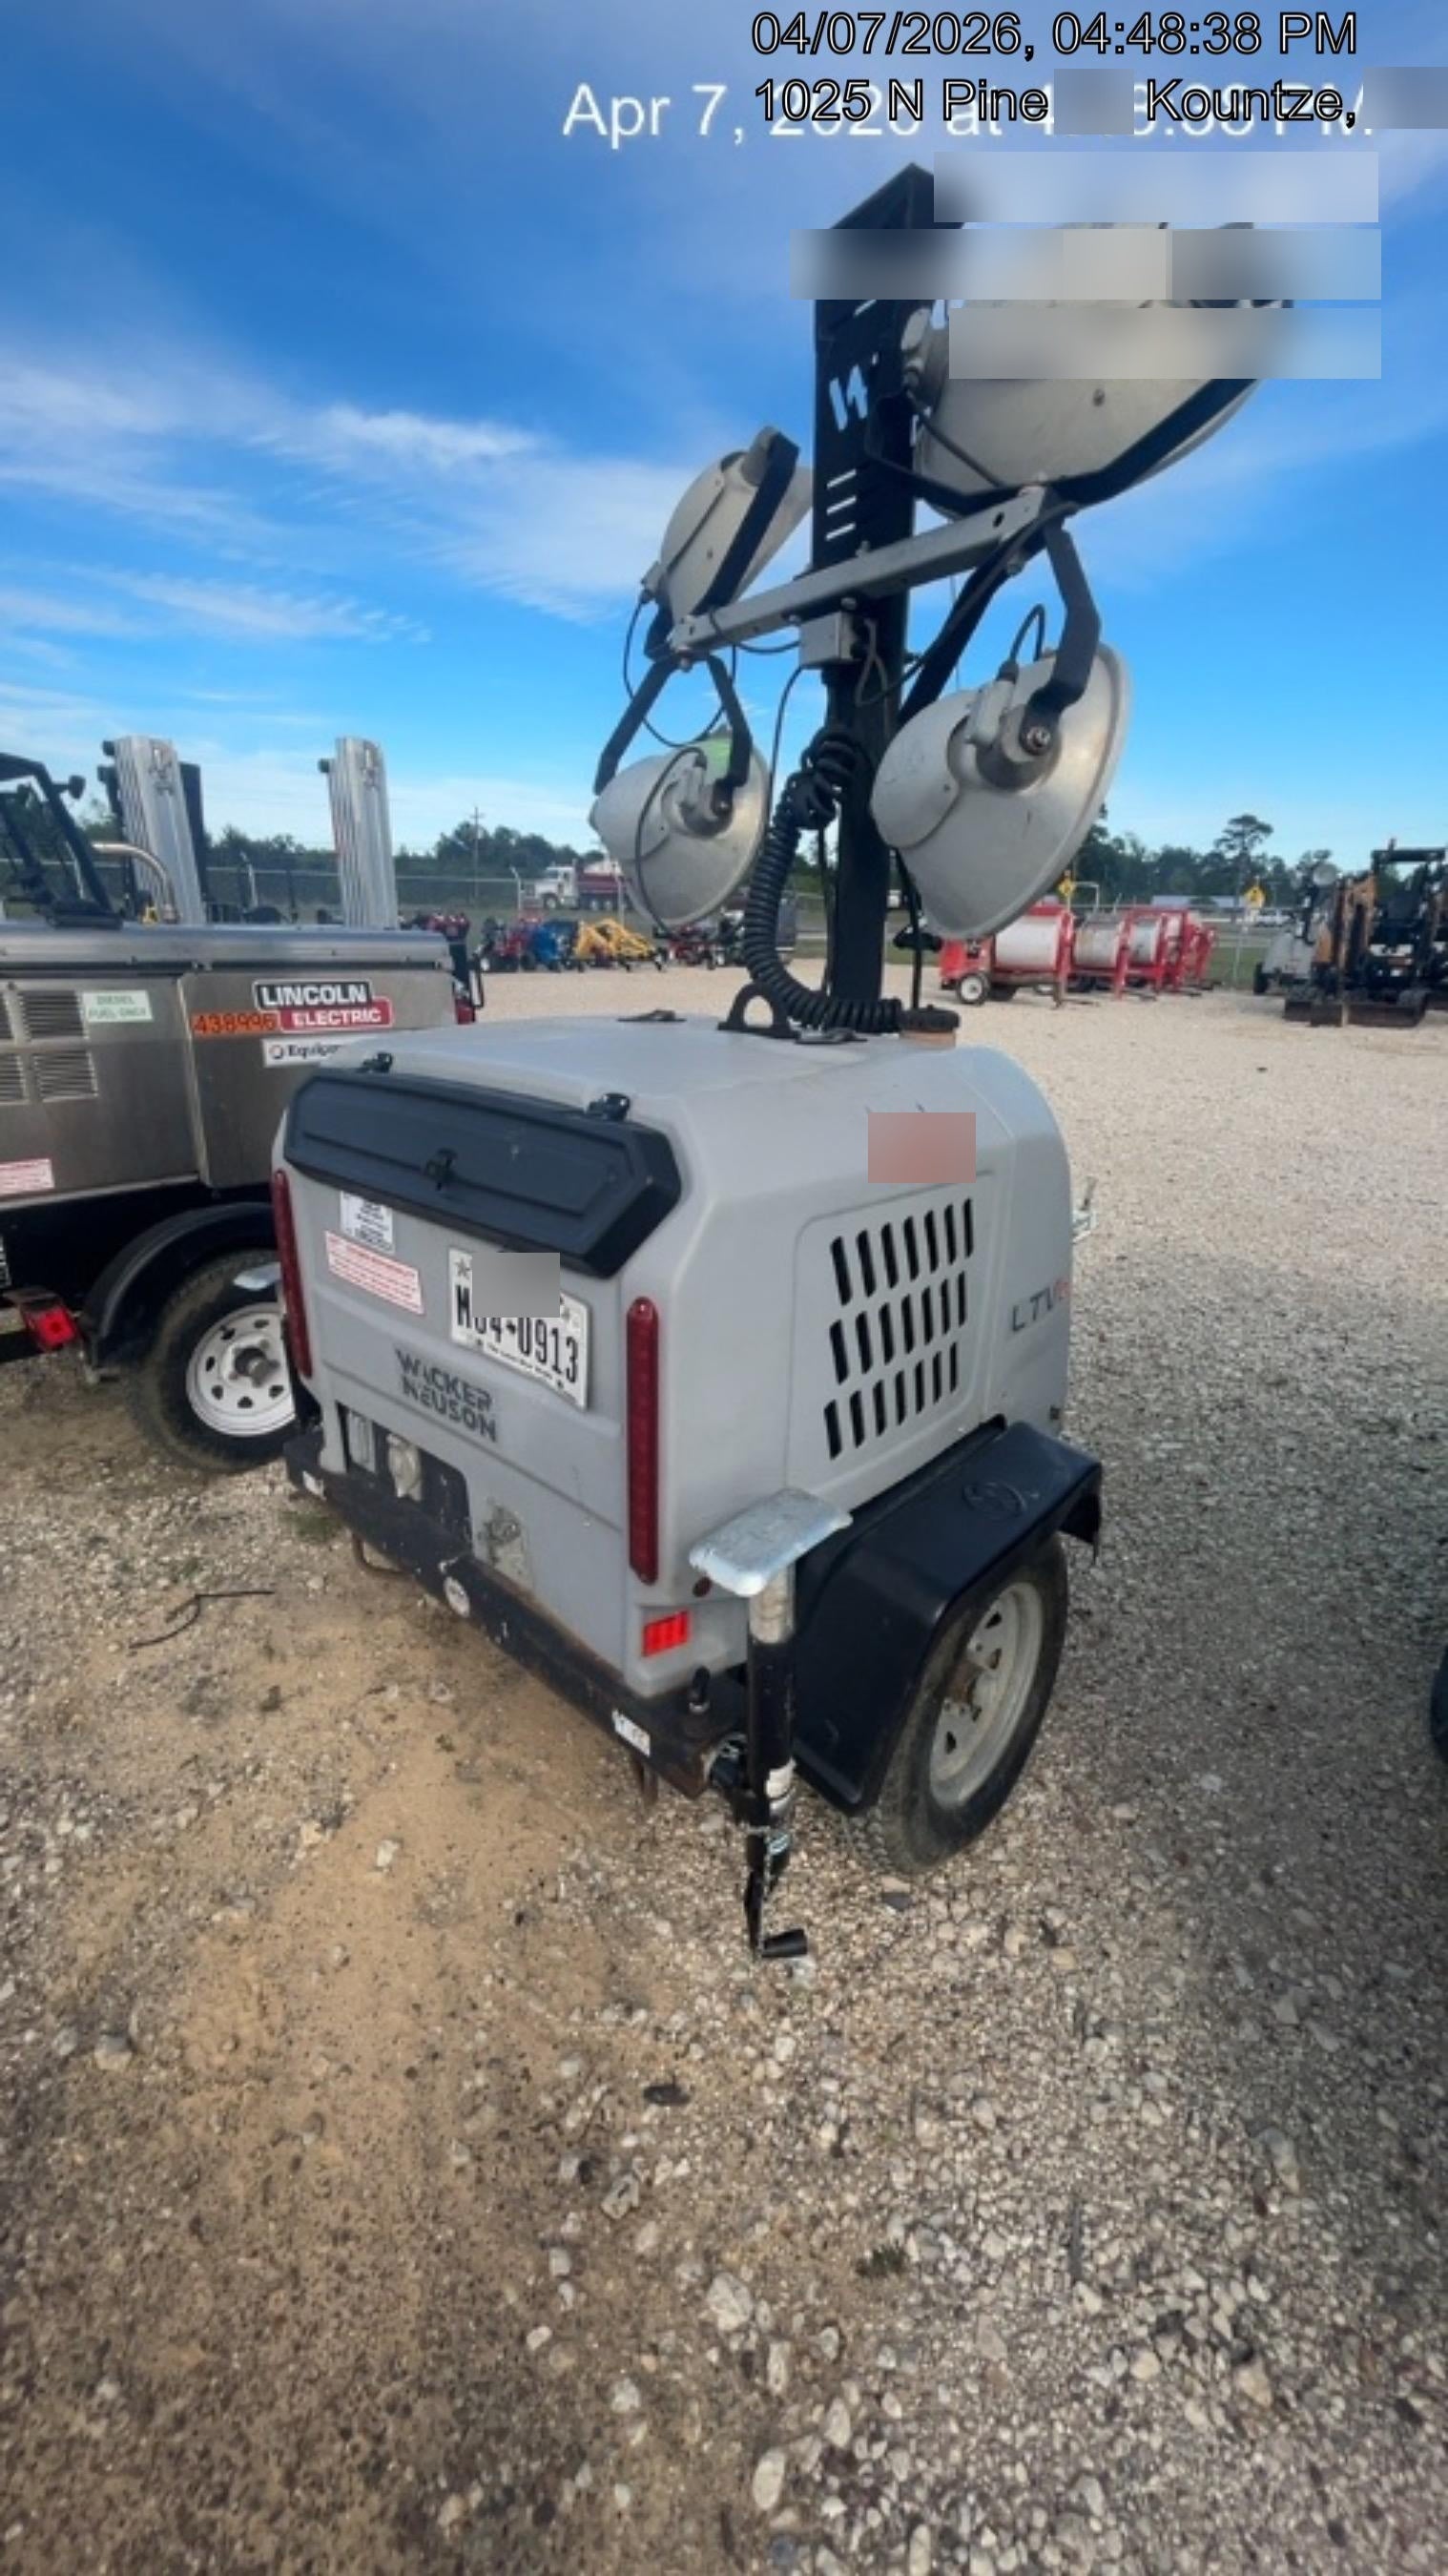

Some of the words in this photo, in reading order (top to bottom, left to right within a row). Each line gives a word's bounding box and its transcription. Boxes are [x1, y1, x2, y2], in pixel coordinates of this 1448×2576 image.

[262, 984, 367, 1007] LINCOLN
[292, 1008, 382, 1028] ELECTRIC
[402, 1375, 497, 1444] NEUSON
